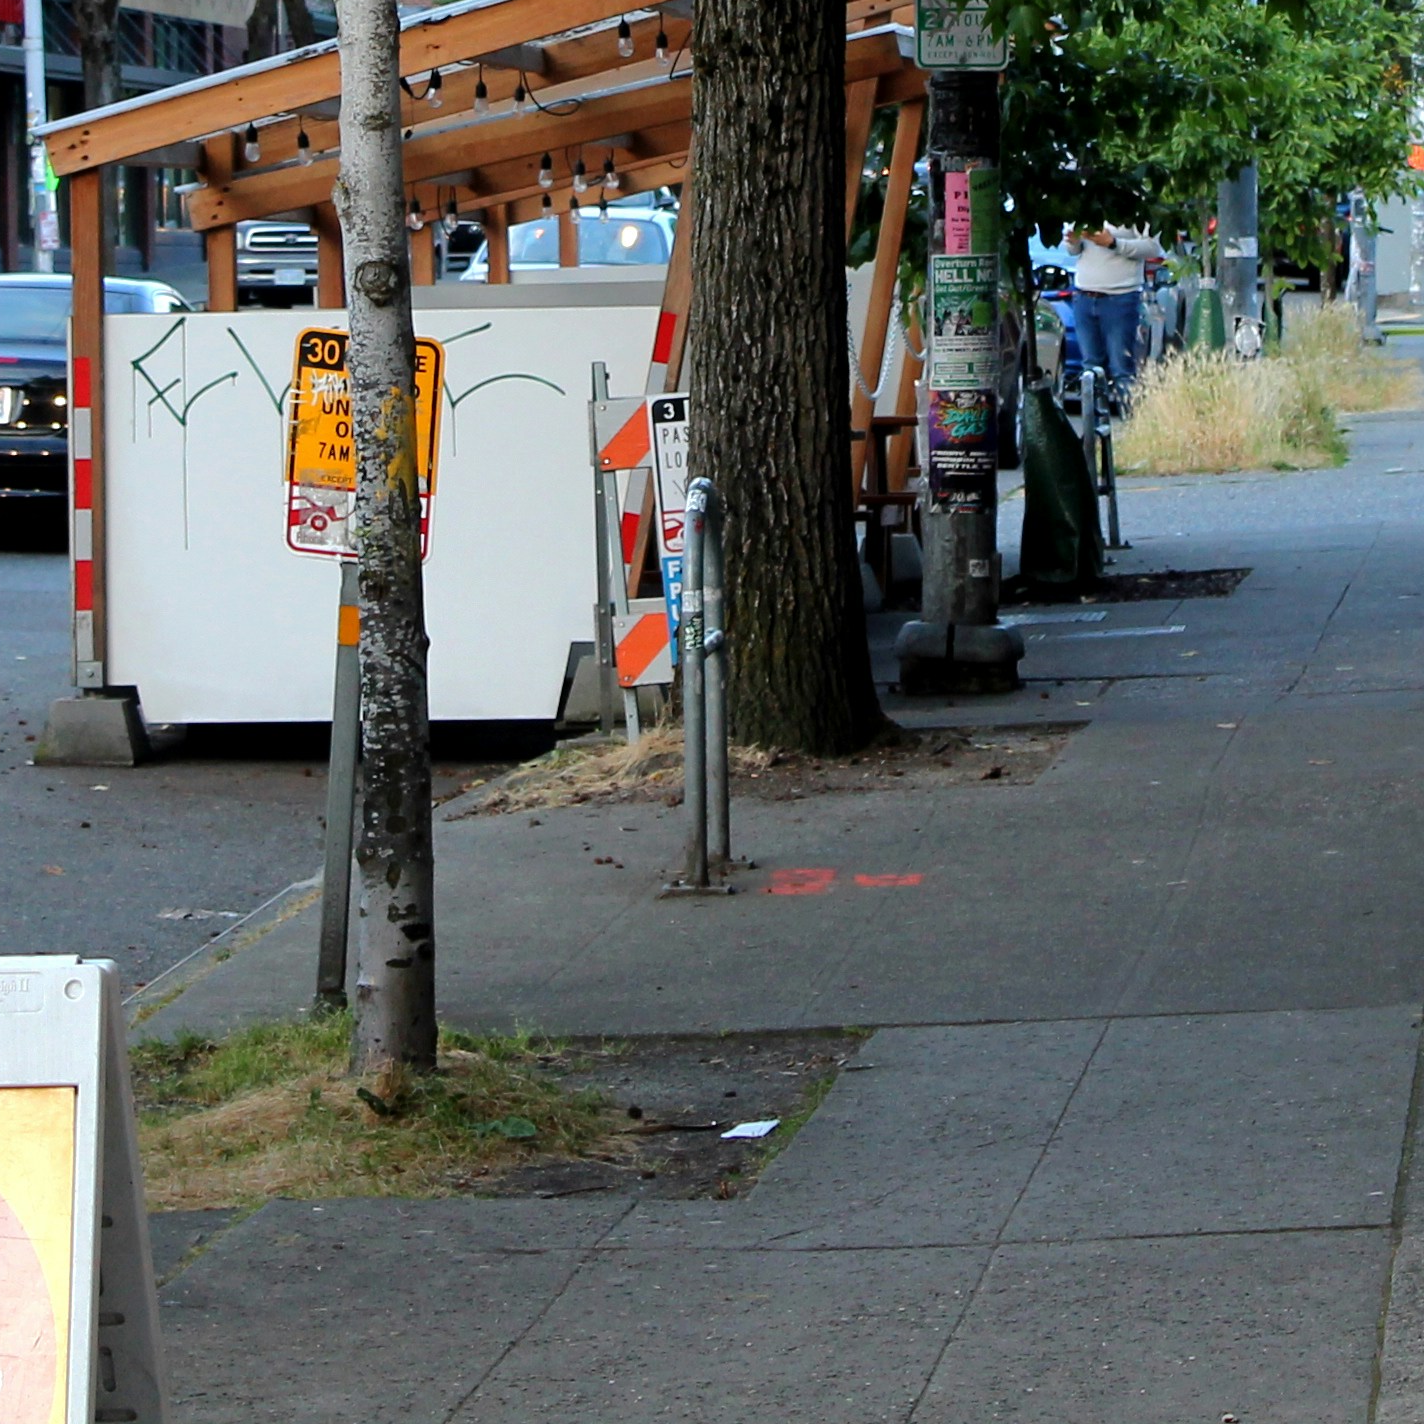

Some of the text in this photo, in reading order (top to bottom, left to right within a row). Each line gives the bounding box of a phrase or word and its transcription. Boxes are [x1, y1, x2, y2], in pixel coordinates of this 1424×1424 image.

[934, 268, 974, 284] HELL
[307, 337, 340, 366] 30
[662, 402, 675, 420] 3
